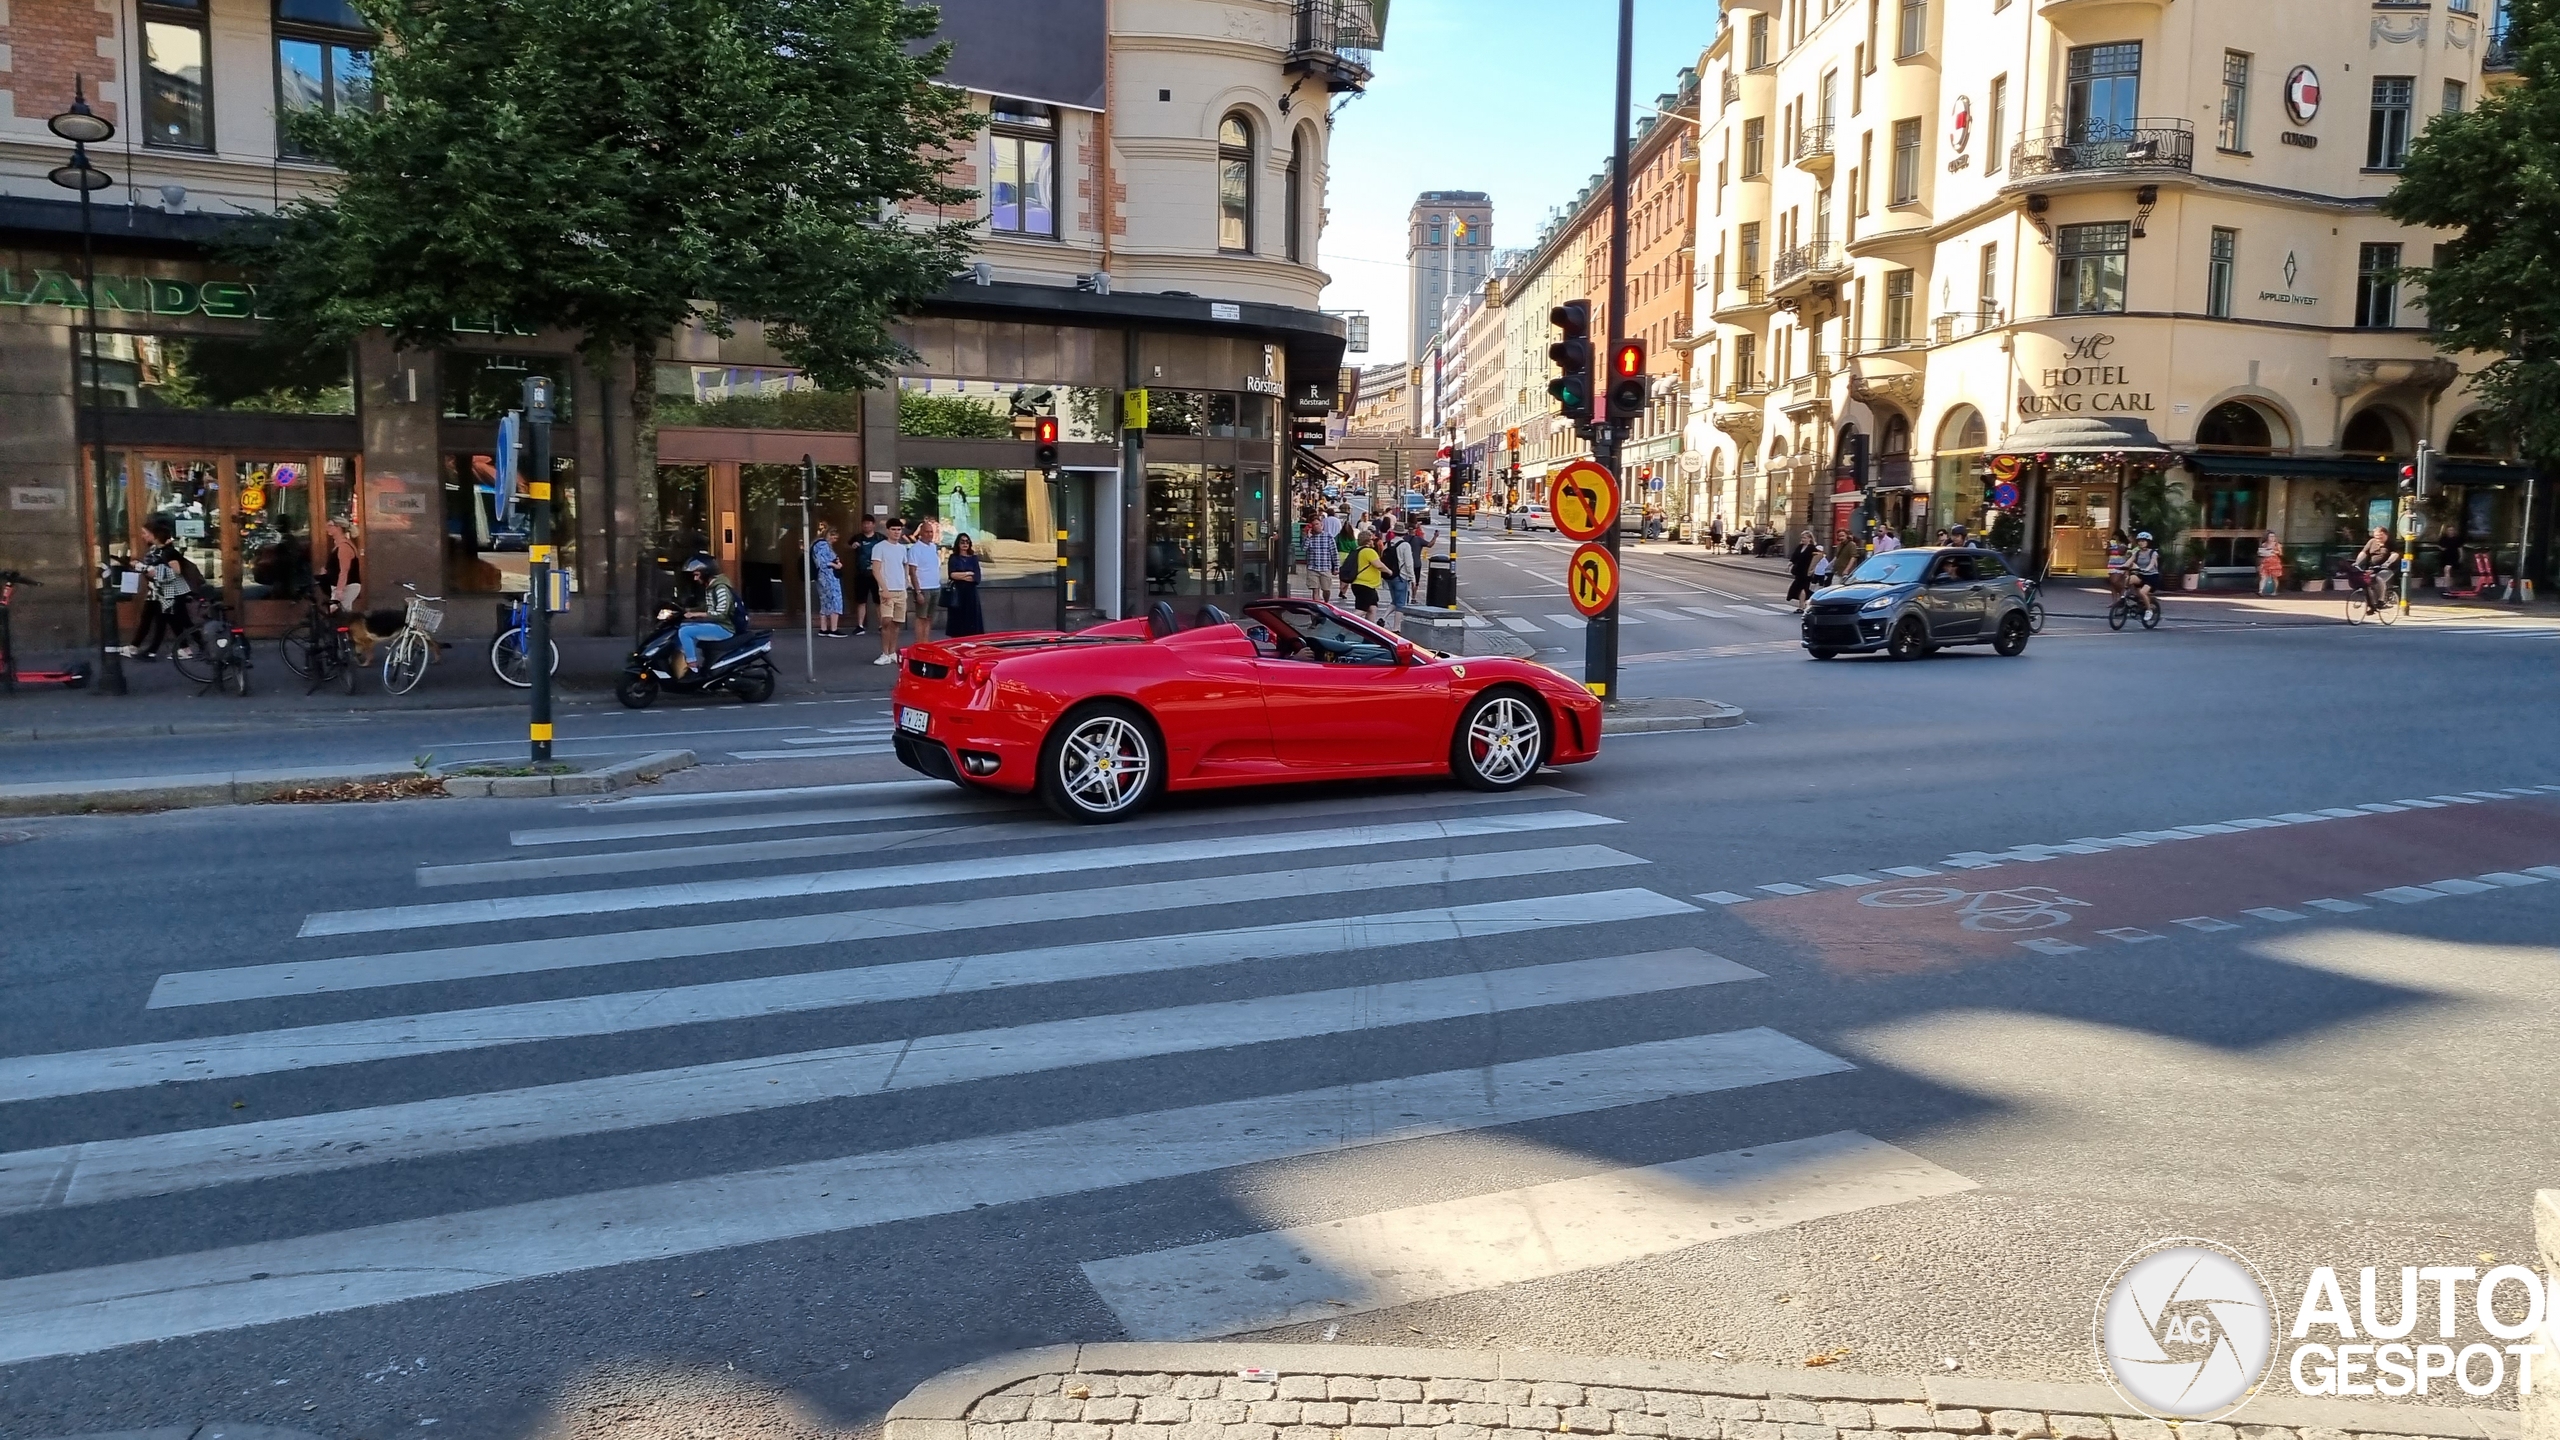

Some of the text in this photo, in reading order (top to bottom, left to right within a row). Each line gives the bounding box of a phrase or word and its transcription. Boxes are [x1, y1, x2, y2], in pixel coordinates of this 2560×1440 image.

[2259, 291, 2319, 305] APPLIED INVEST
[2063, 333, 2115, 360] KC
[1265, 354, 1274, 377] R
[2042, 366, 2129, 387] HOTEL
[1299, 398, 1330, 406] Rörstrand
[1311, 389, 1319, 398] R
[2018, 394, 2082, 414] KUNG
[2092, 392, 2155, 411] CARL
[20, 493, 56, 504] Bank
